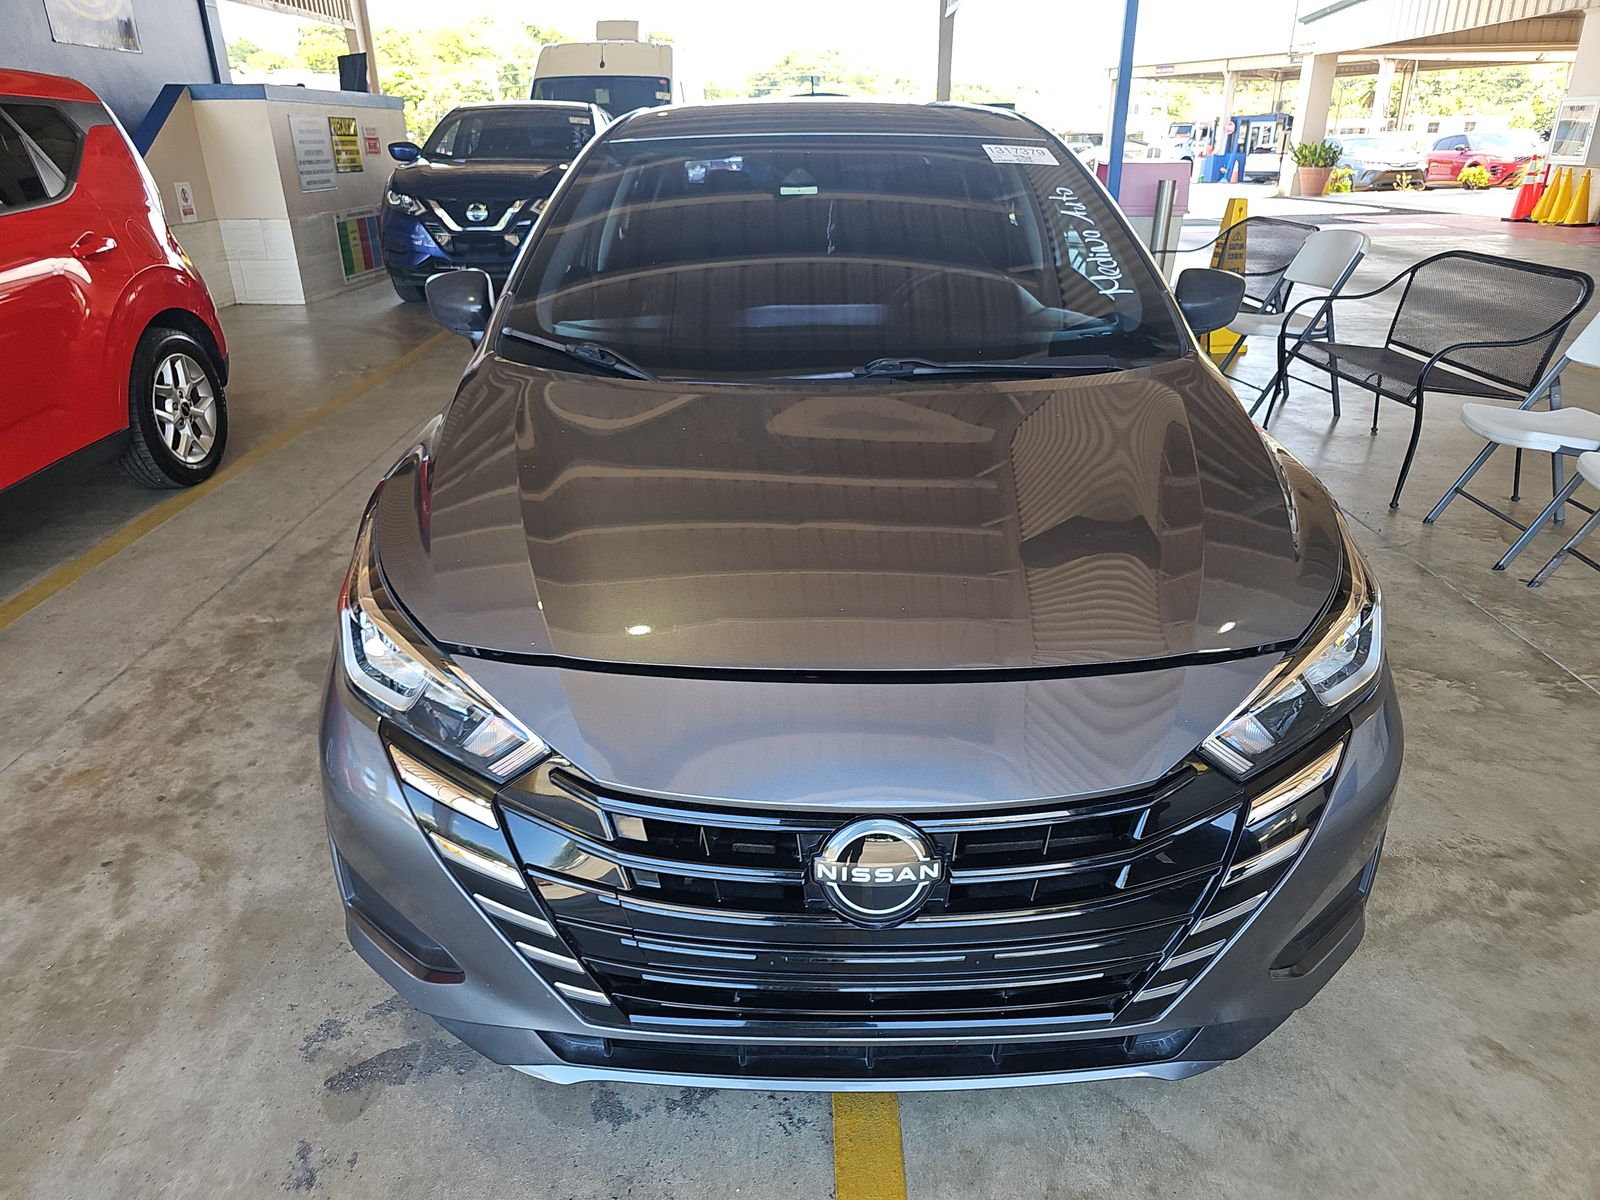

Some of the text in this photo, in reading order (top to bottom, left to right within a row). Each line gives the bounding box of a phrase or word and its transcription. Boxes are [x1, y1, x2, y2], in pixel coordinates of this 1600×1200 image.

[987, 146, 1046, 157] 1317379
[1048, 186, 1095, 226] Auto
[816, 862, 939, 883] NISSAN
